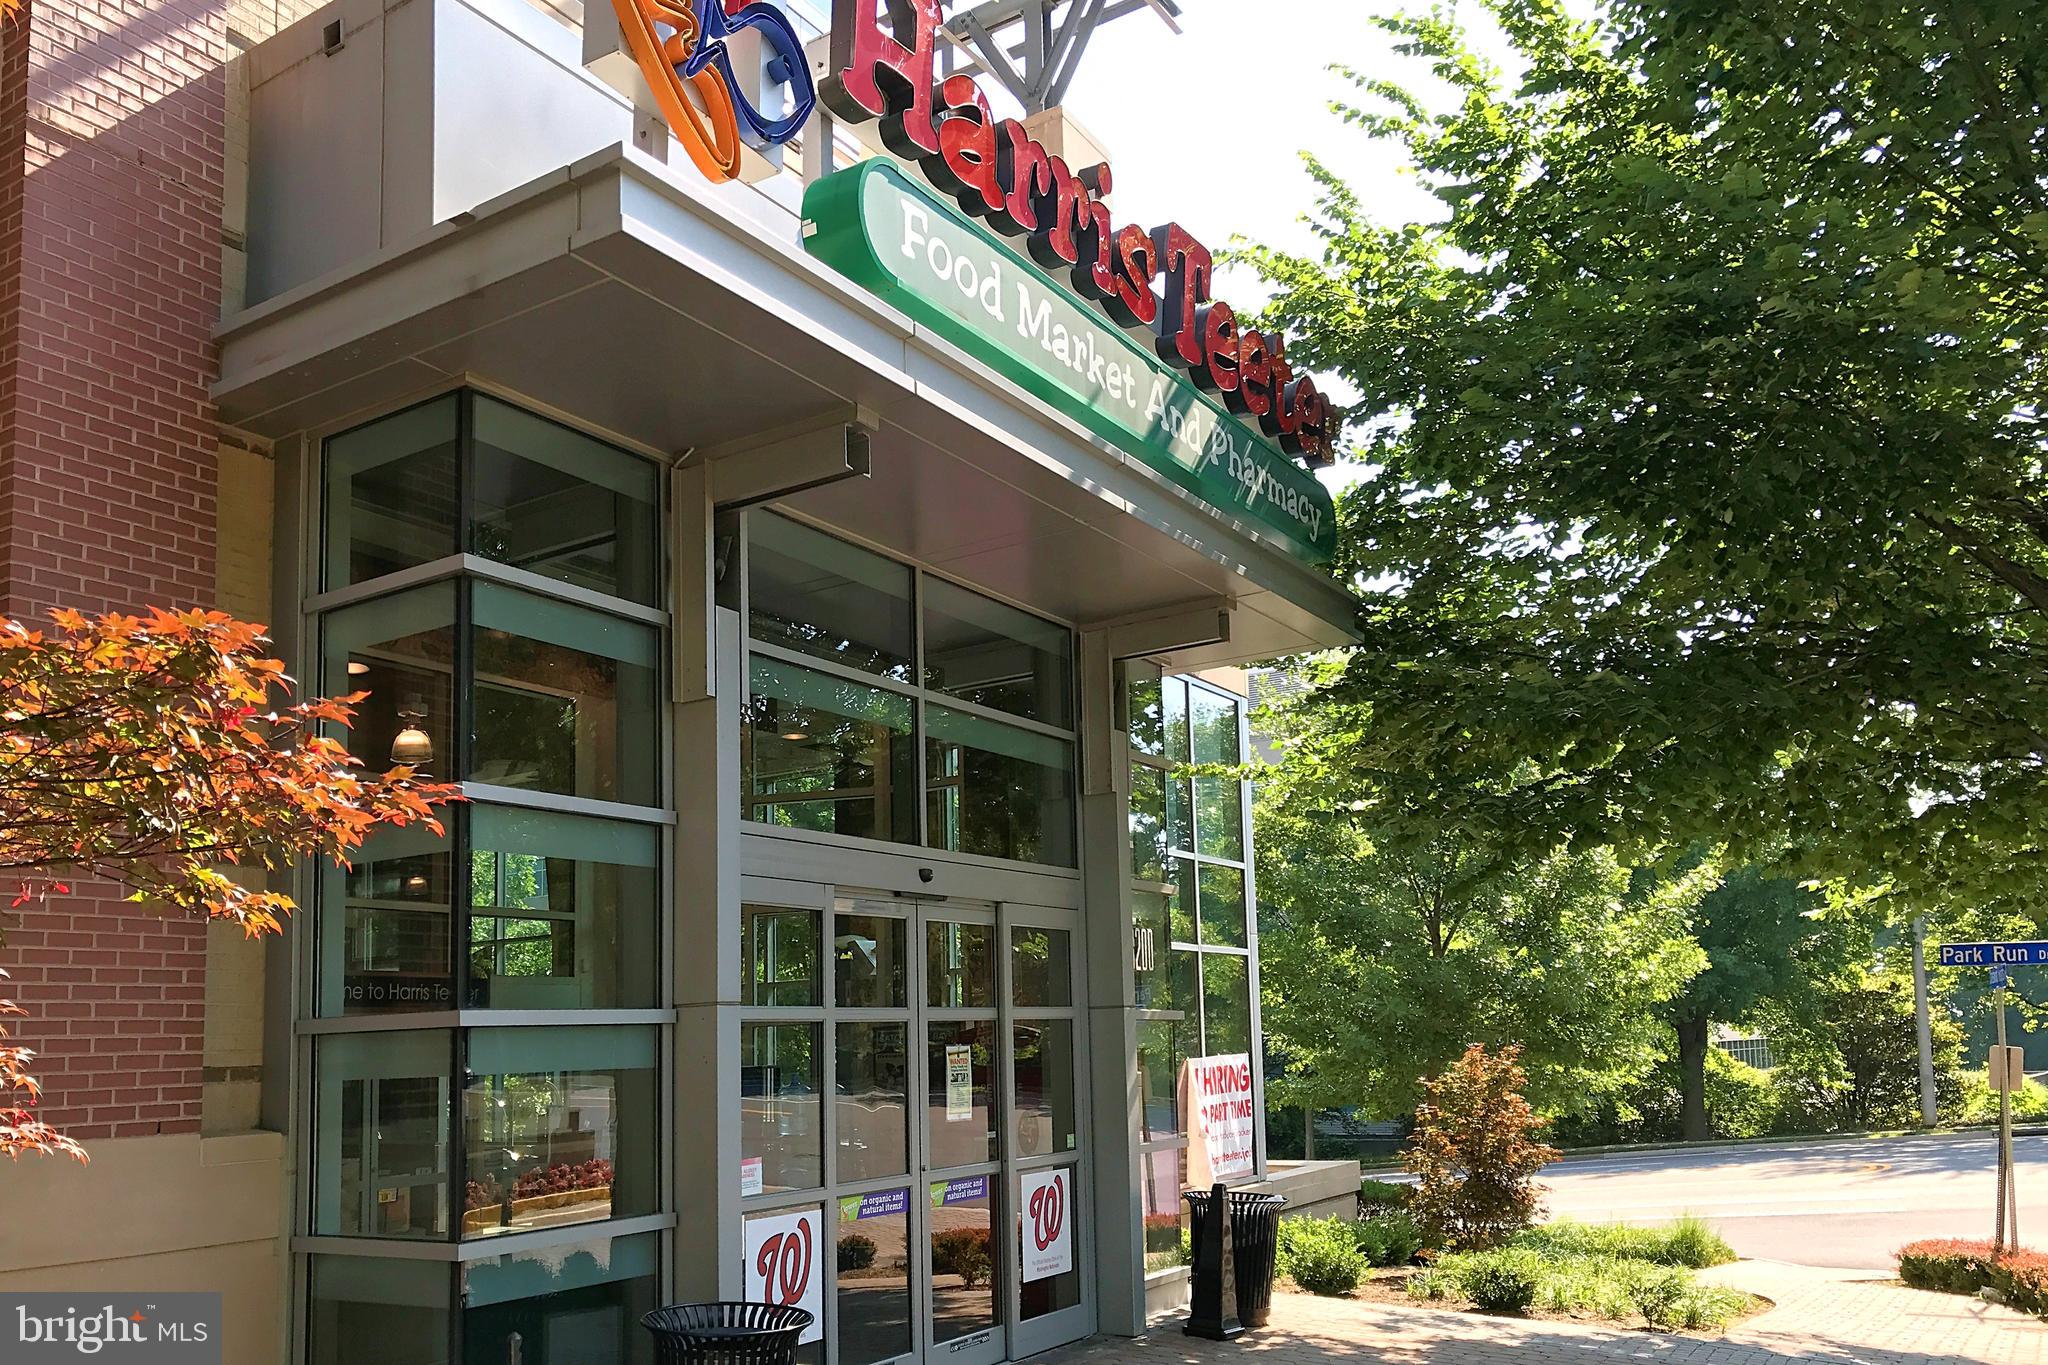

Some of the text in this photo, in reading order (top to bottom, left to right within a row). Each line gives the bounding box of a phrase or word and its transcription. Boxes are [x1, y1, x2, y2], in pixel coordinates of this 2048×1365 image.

[836, 0, 1343, 465] Harris Teeter
[900, 198, 1322, 543] Food Market And Pharmacy
[1132, 928, 1154, 971] 200
[1942, 946, 1983, 963] Park
[1993, 945, 2028, 962] Run
[368, 983, 384, 1000] to
[389, 983, 430, 1000] Harris
[1203, 1062, 1250, 1096] HIRING
[1210, 1101, 1228, 1123] PART
[1230, 1099, 1252, 1119] TIME
[945, 1178, 983, 1193] on organic and
[947, 1187, 983, 1201] natural items!
[860, 1191, 904, 1206] on organic and
[862, 1201, 903, 1215] natural items!
[1030, 1174, 1064, 1251] W
[757, 1217, 812, 1317] W
